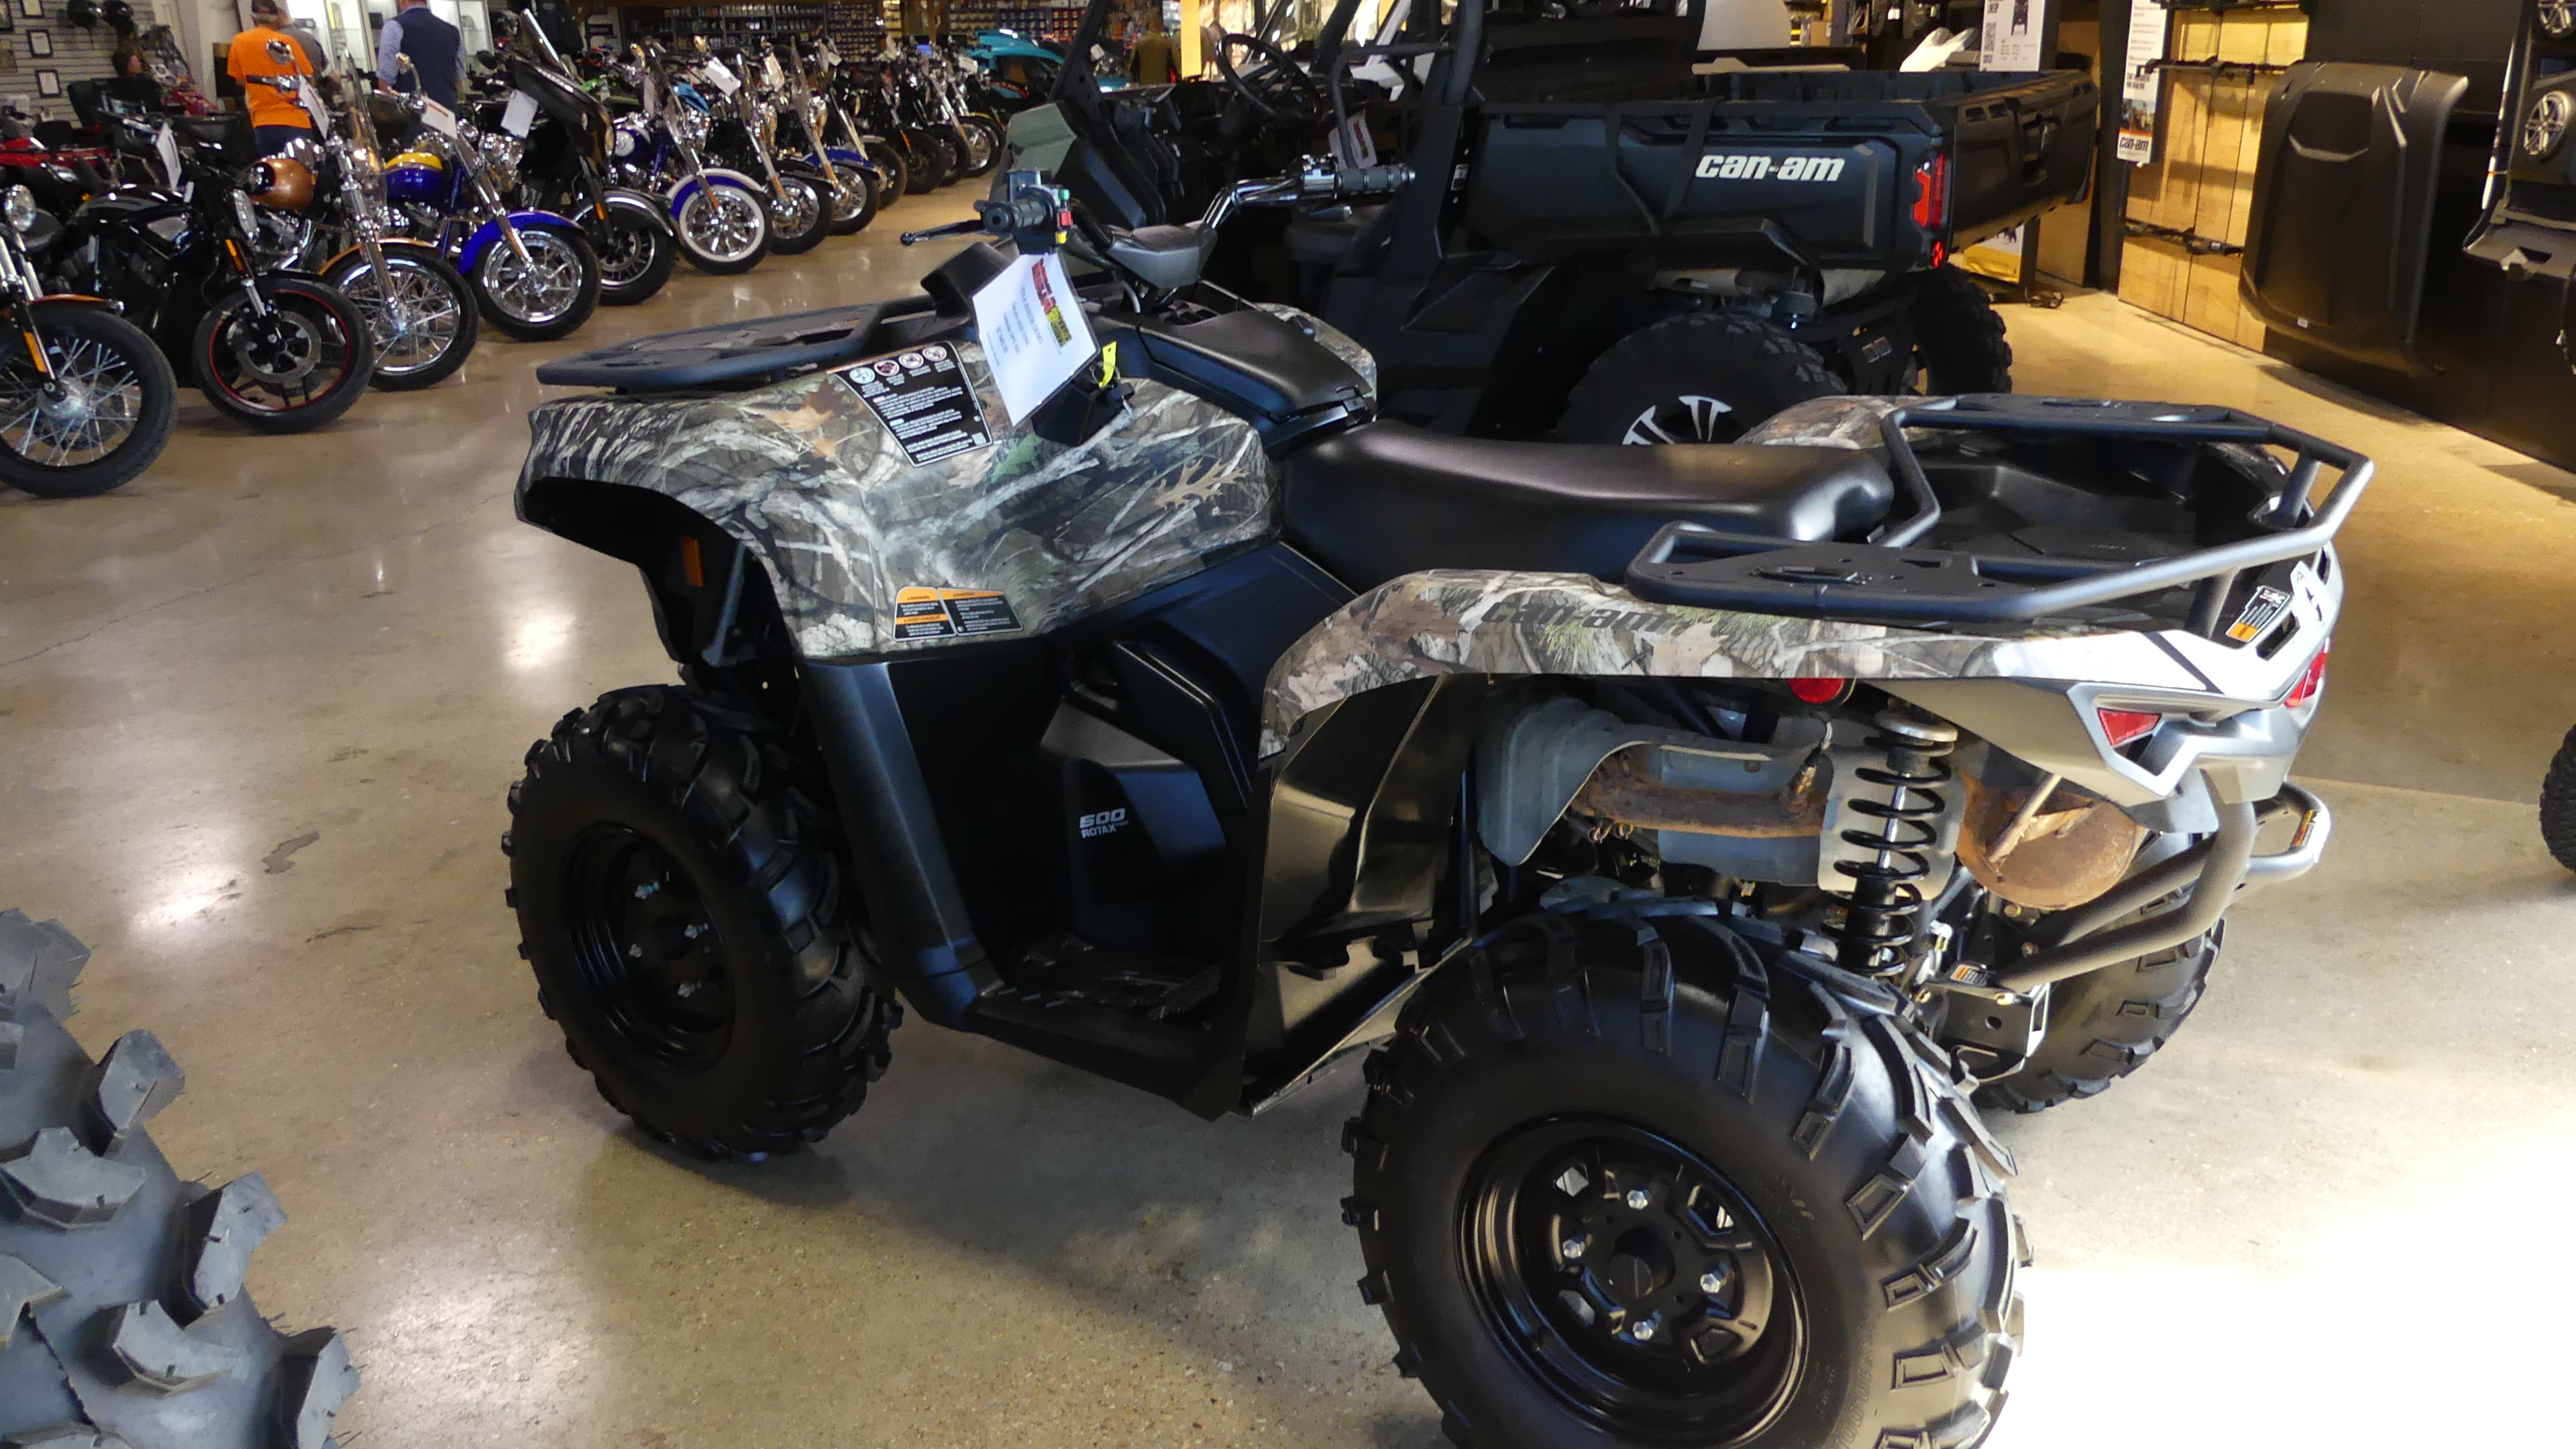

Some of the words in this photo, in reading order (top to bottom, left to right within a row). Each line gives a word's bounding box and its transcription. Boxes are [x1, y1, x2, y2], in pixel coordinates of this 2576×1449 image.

[2120, 137, 2149, 152] can-am
[1695, 155, 1845, 182] can-am
[1081, 824, 1116, 839] ROTAX
